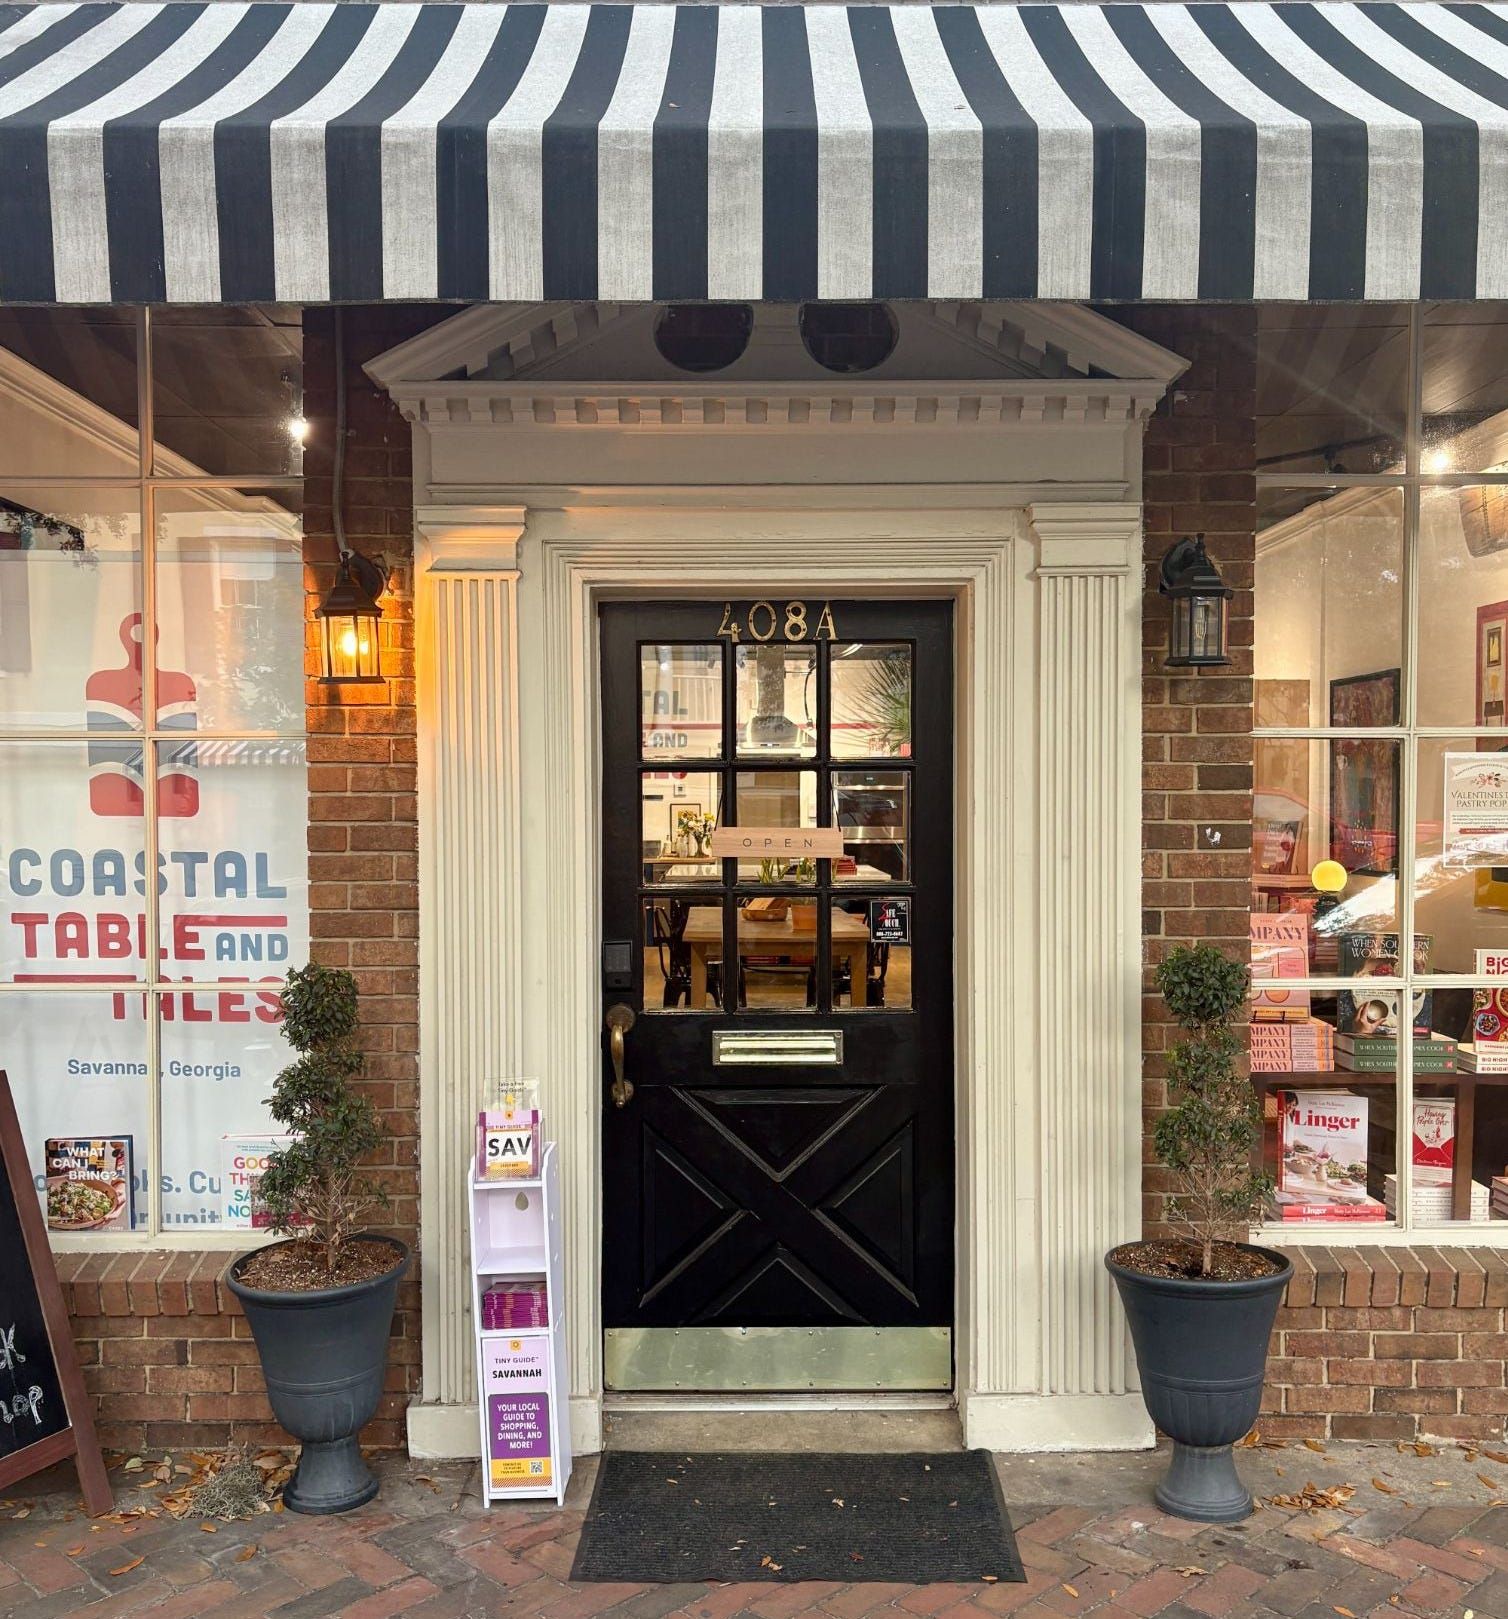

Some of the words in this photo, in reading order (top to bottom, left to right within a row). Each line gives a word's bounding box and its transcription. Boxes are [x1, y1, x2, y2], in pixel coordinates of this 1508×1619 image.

[717, 601, 839, 642] 408A
[1451, 791, 1503, 799] VALENTINES
[1456, 800, 1488, 808] PASTRY
[742, 837, 814, 849] OPEN
[9, 848, 287, 898] COASTAL
[11, 911, 206, 960] TABLE
[215, 932, 289, 961] AND
[1249, 926, 1305, 940] MPANY
[1352, 938, 1378, 948] WHEN
[1351, 947, 1391, 959] WOMEN
[1251, 1026, 1287, 1036] MPANY
[1251, 1038, 1287, 1048] MPANY
[1251, 1049, 1288, 1059] MPANY
[67, 1058, 164, 1077] Savanna,
[169, 1060, 242, 1082] Georgia
[1252, 1061, 1288, 1071] MPANY
[1294, 1109, 1361, 1132] Linger
[488, 1134, 532, 1157] SAV
[67, 1146, 105, 1158] WHAT
[52, 1158, 80, 1169] CAN
[68, 1170, 116, 1181] BRING?
[492, 1368, 542, 1379] SAVANNAH
[497, 1403, 517, 1412] YOUR
[518, 1402, 540, 1411] LOCAL
[503, 1412, 525, 1421] GUIDE
[526, 1412, 535, 1420] TO
[500, 1422, 539, 1431] SHOPPING,
[497, 1432, 526, 1441] DINING,
[527, 1431, 542, 1439] AND
[509, 1441, 533, 1449] MORE!
